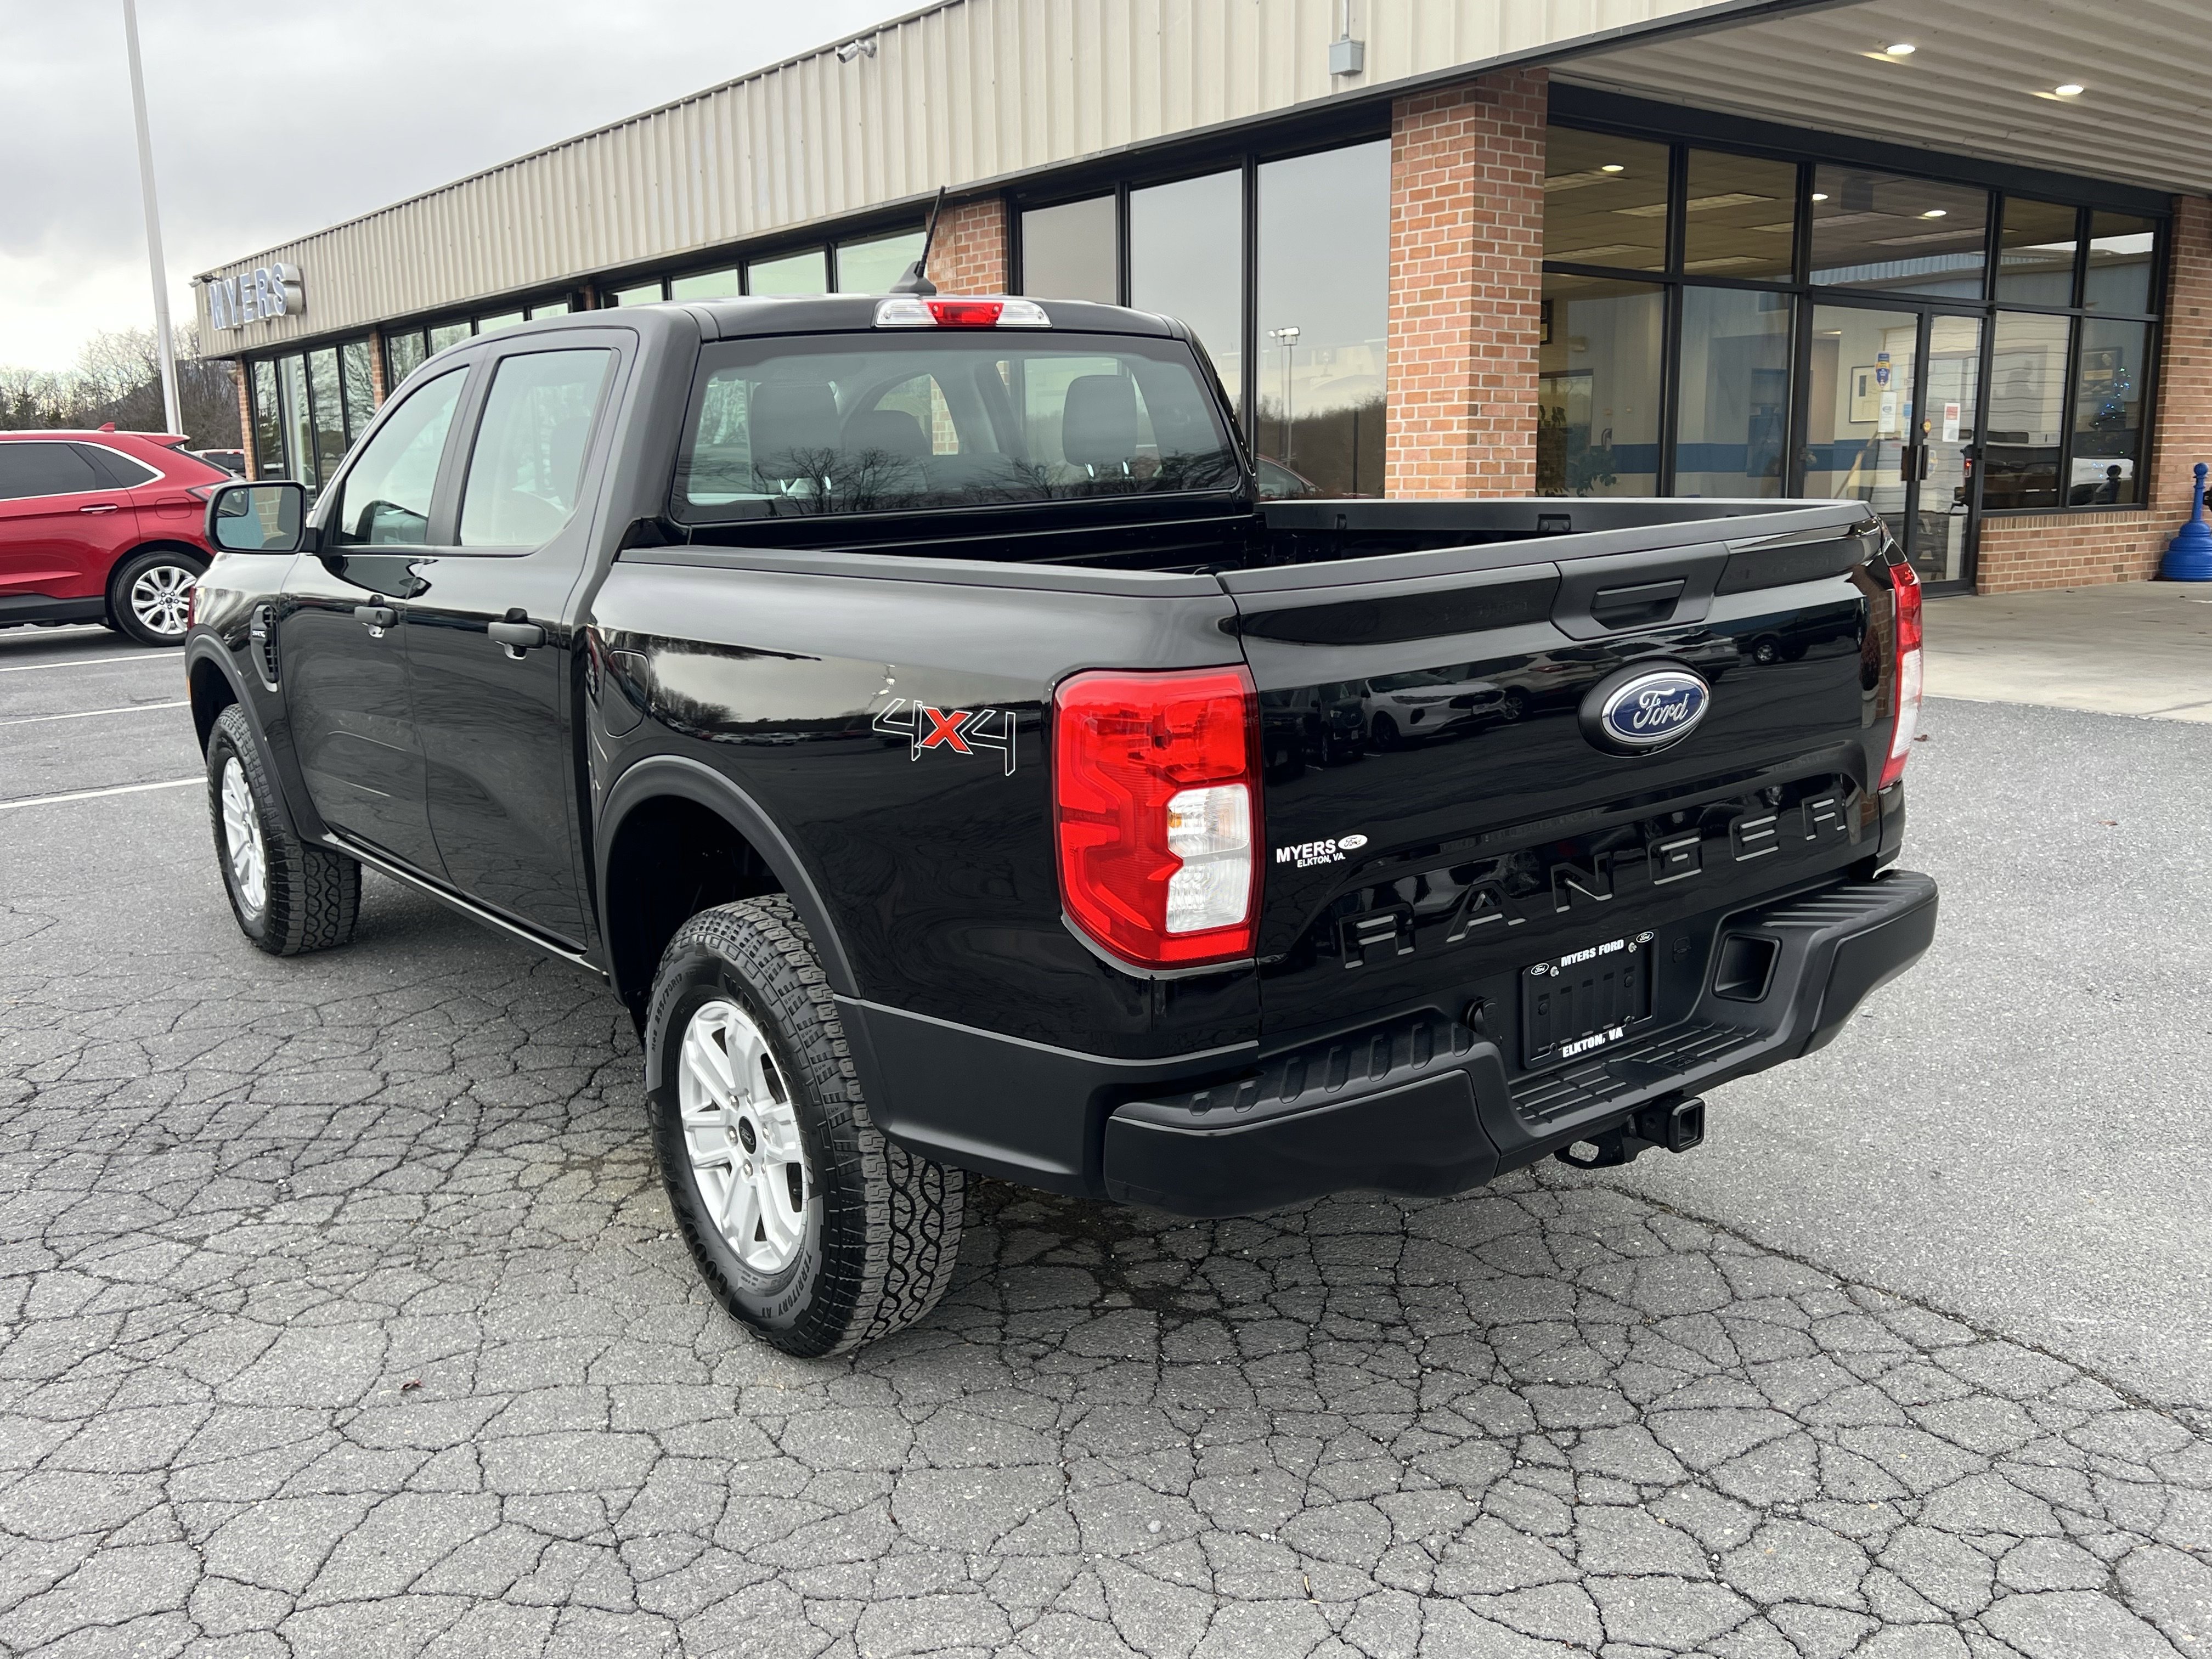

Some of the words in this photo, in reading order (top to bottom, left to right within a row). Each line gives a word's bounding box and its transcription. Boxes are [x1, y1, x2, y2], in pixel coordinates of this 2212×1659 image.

[210, 262, 290, 331] MYERS
[1633, 687, 1690, 729] Ford
[1277, 839, 1336, 863] MYERS
[1297, 854, 1331, 868] ELKTON,
[1339, 795, 1847, 970] RANGER
[1561, 947, 1596, 967] MYERS
[1599, 939, 1624, 956] FORD
[1562, 1034, 1606, 1058] ELKTON,
[1608, 1027, 1623, 1040] VA
[778, 1250, 812, 1317] TERRITORY
